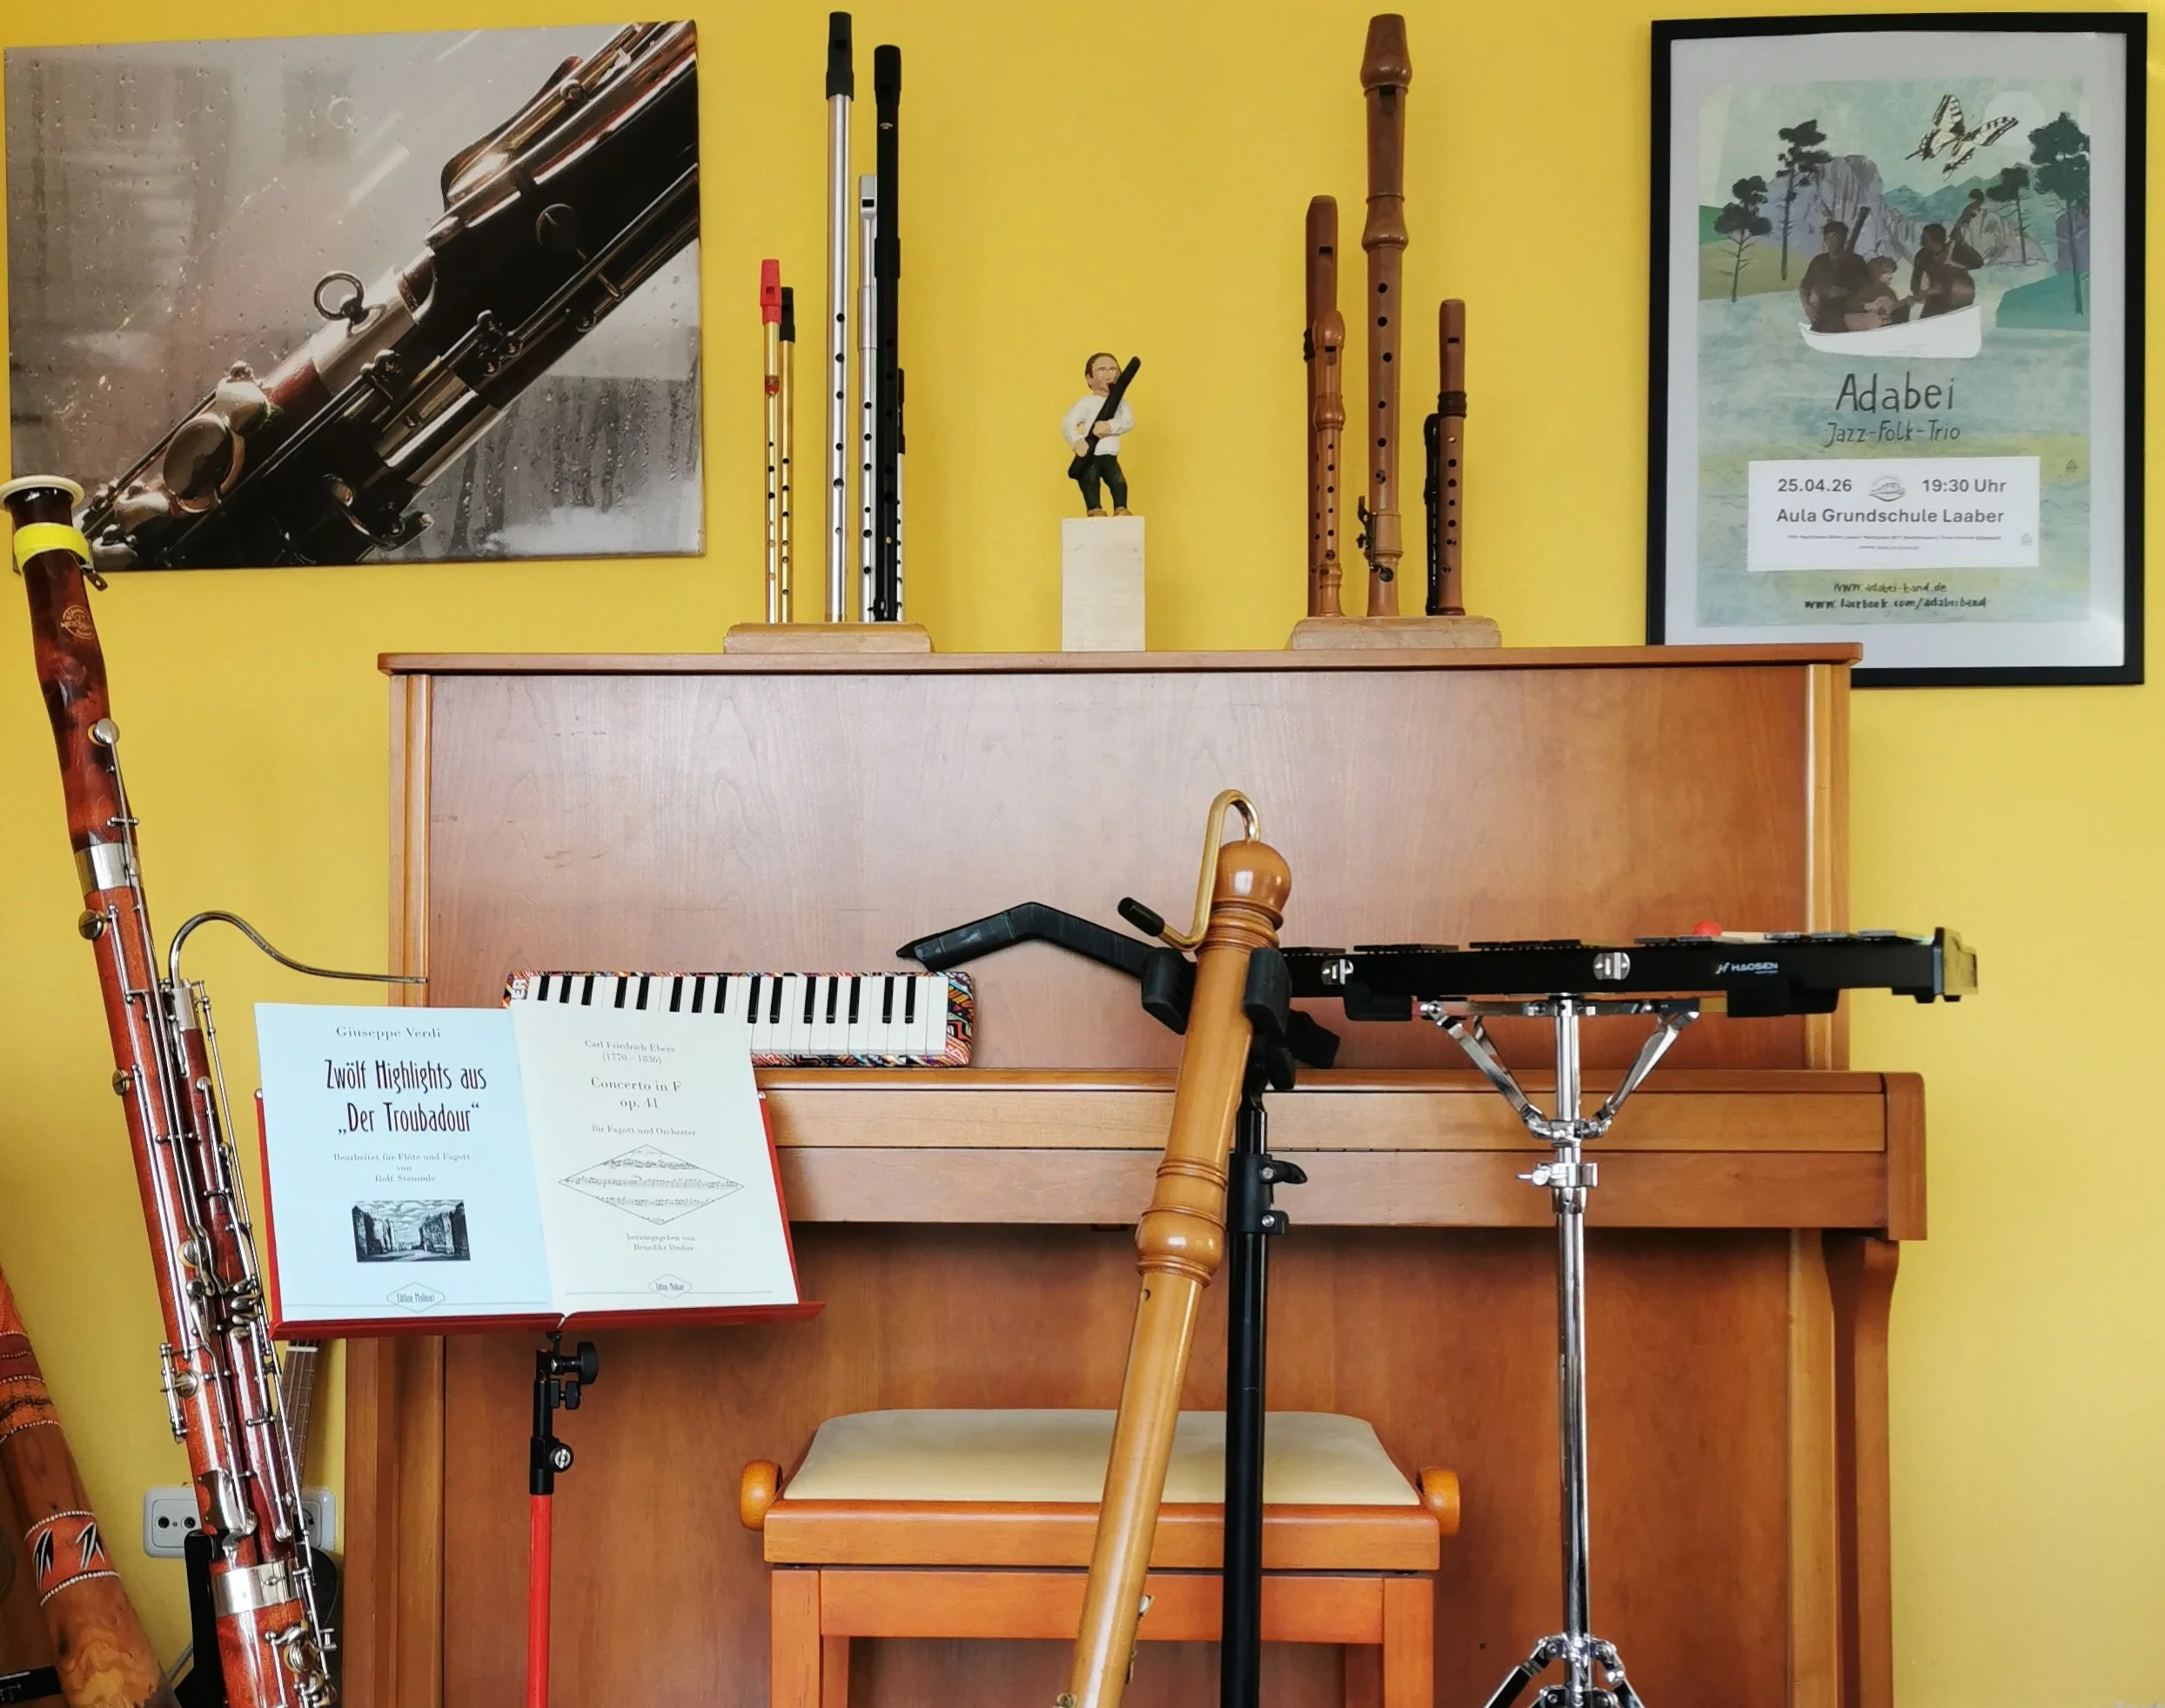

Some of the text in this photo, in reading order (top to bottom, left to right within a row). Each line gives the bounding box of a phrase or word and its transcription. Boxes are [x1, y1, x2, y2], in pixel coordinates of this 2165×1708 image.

[1835, 371, 1954, 414] Adabei
[1825, 419, 1961, 448] Jazz-Folk-Trio
[1777, 479, 2007, 492] 25.04.26 19:30 Uhr
[1776, 508, 2005, 523] Aula Grundschule Laaber
[336, 1026, 441, 1041] Giuseppe Verdi
[585, 1039, 603, 1048] Carl
[607, 1041, 647, 1051] Friedrich
[324, 1059, 486, 1094] Zwölf Highlights aus
[591, 1076, 682, 1092] Concerto in F
[620, 1097, 658, 1111] op. 41
[338, 1102, 479, 1135] „Der Troubadour“
[607, 1124, 635, 1135] Fagott
[656, 1127, 697, 1136] Orchester
[443, 1153, 471, 1162] Fagott
